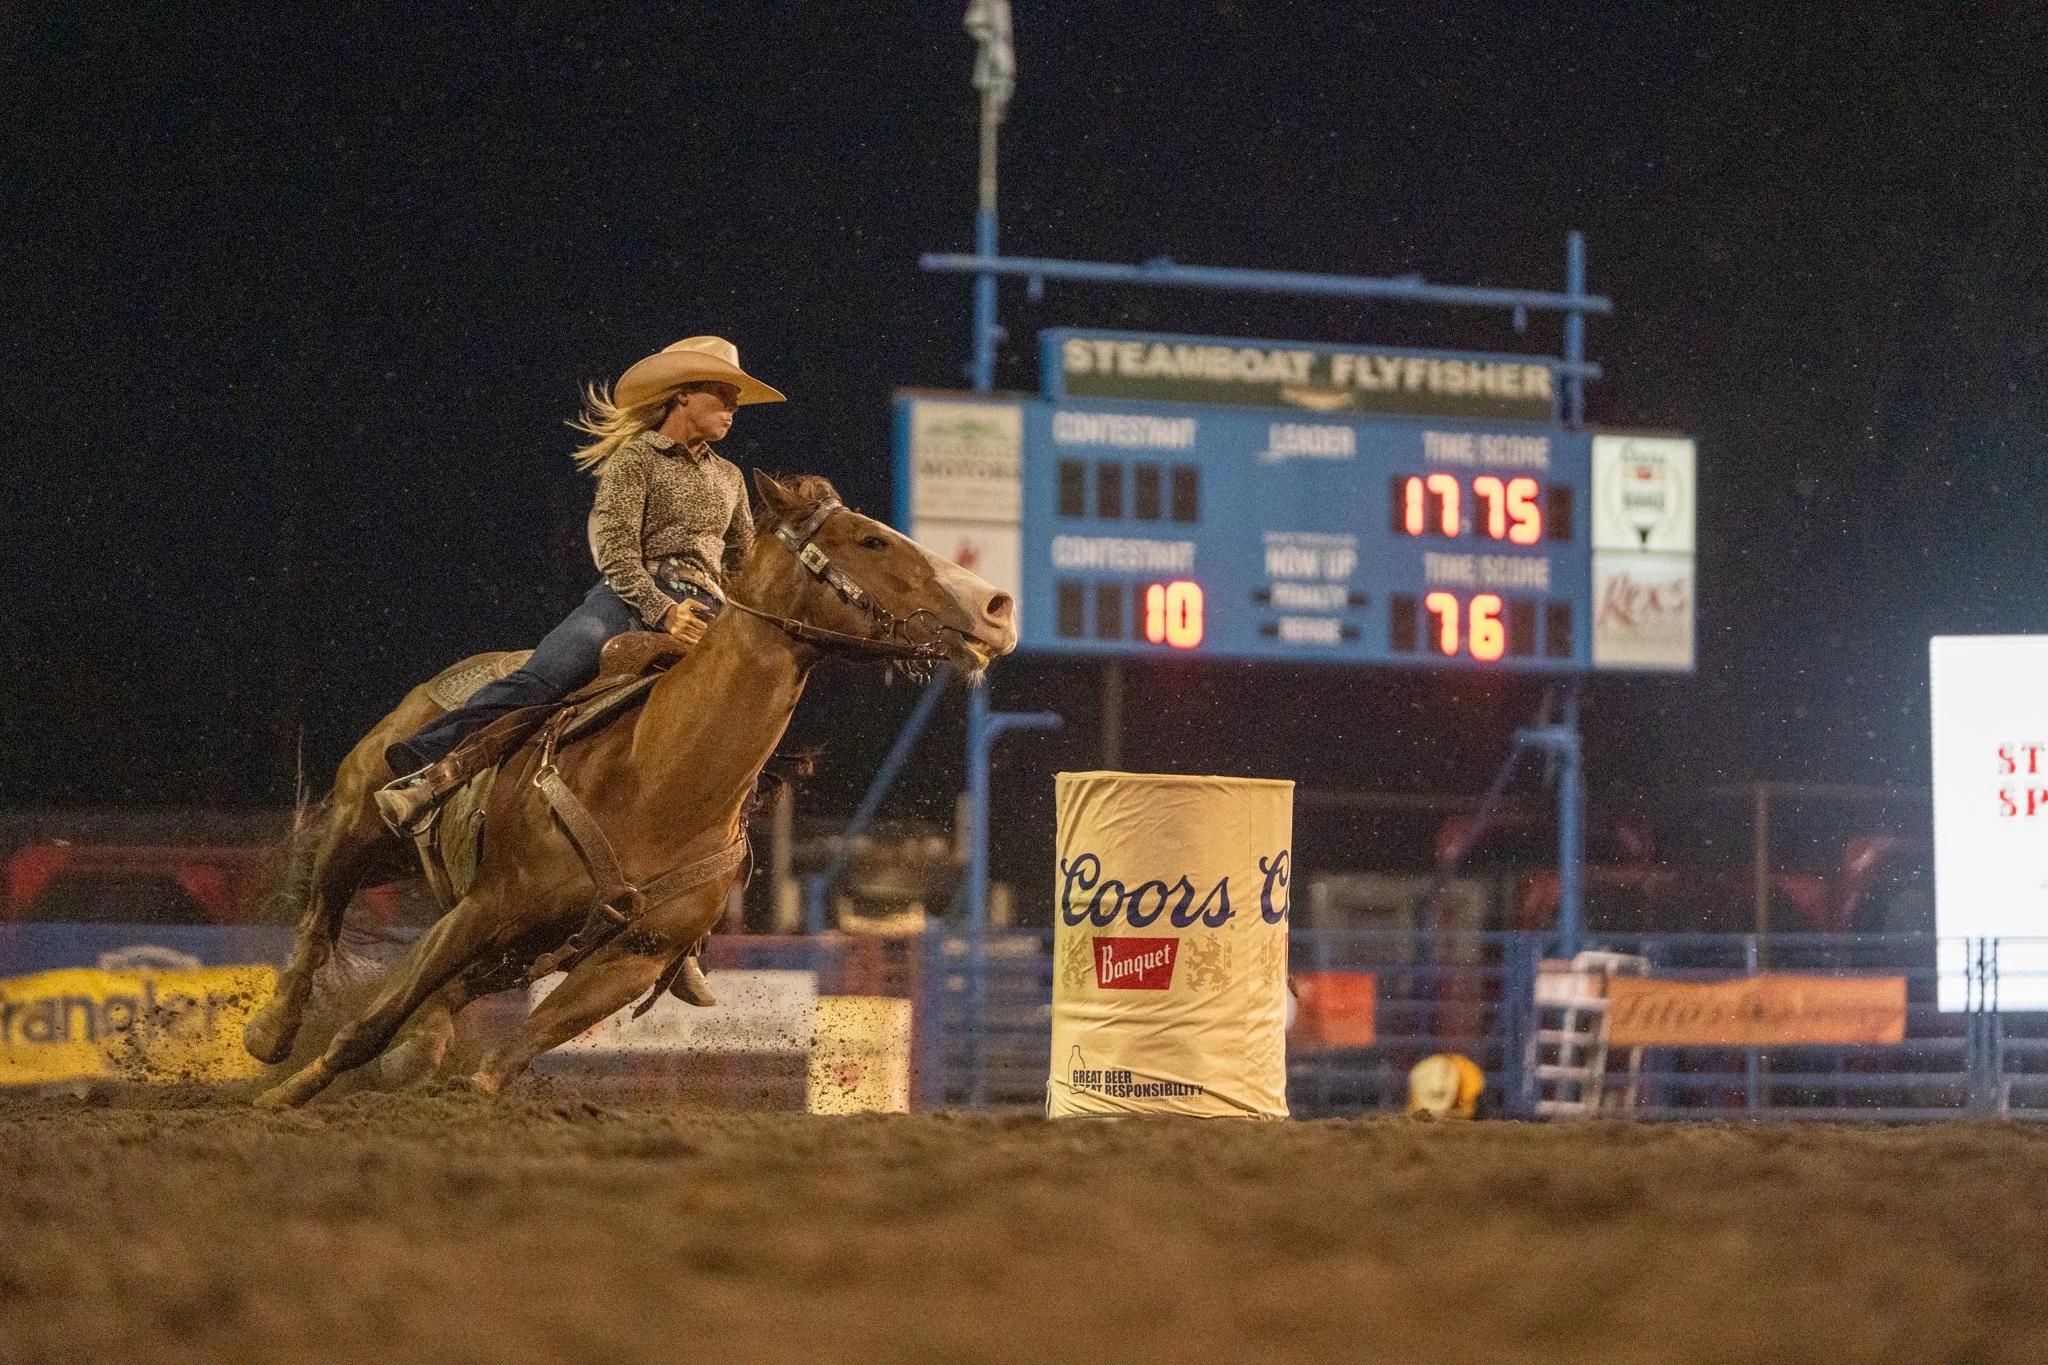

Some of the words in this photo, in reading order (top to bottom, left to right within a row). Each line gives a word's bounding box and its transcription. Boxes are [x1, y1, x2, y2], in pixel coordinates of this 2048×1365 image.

[1064, 338, 1315, 384] STEAMBOAT
[1332, 354, 1551, 397] FLYFISHER
[1423, 432, 1473, 464] TIME
[1479, 434, 1548, 469] SCORE
[1424, 552, 1474, 584] TIME
[1479, 555, 1549, 590] SCORE
[1146, 581, 1203, 649] 10
[1060, 853, 1236, 928] Coors
[1101, 943, 1172, 984] Banquet
[1073, 1069, 1102, 1083] GREAT
[1105, 1070, 1132, 1083] BEER
[1105, 1083, 1204, 1097] RESPONSIBILITY
